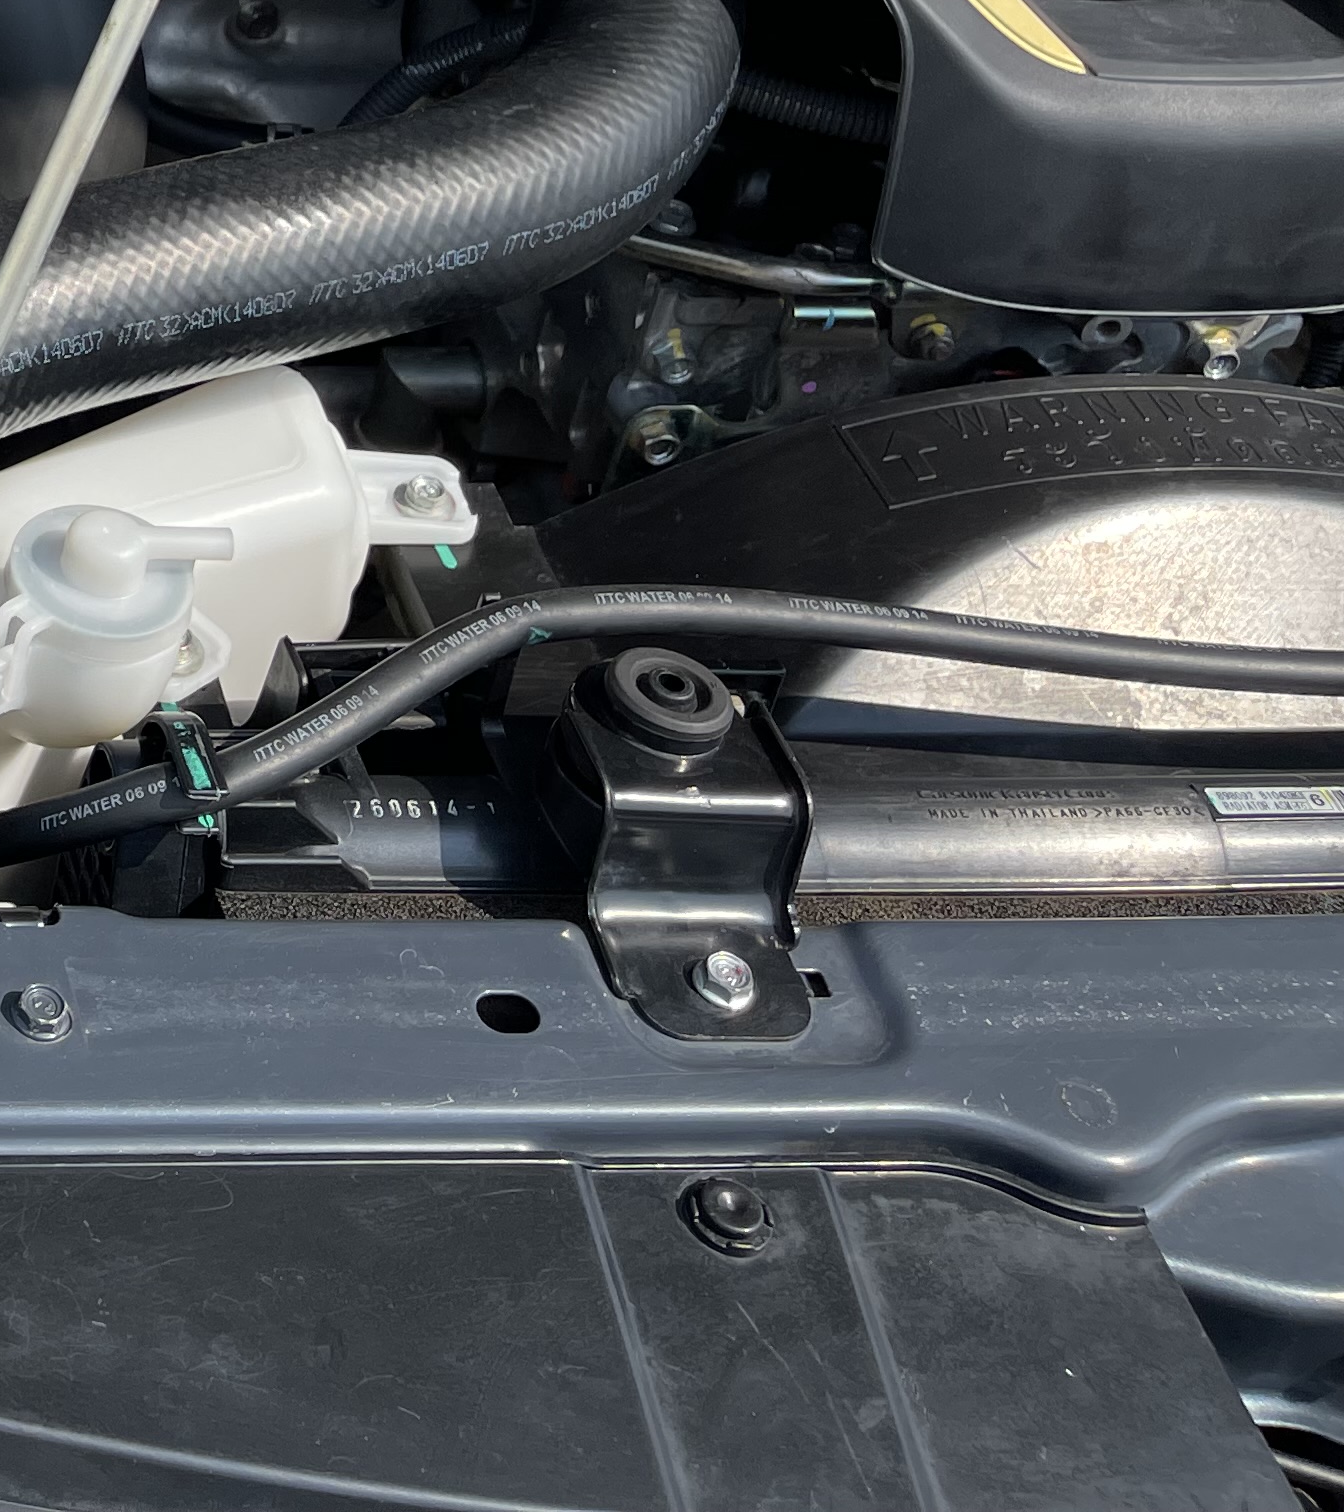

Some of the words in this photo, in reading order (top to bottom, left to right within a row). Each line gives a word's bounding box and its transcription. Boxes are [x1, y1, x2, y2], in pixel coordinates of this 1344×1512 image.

[626, 590, 679, 604] WATER
[715, 592, 733, 605] 14
[820, 599, 873, 616] WATER
[892, 607, 911, 619] 09
[911, 609, 928, 621] 14
[445, 618, 493, 649] WATER
[490, 610, 507, 627] 06
[505, 604, 523, 621] 09
[522, 599, 542, 615] 14
[282, 714, 333, 748] WATER
[331, 700, 349, 720] 06
[345, 694, 363, 712] 09
[69, 793, 124, 821] WATER
[125, 786, 145, 803] 06
[148, 779, 168, 794] 09
[172, 776, 181, 788] 1
[1222, 801, 1270, 811] RADIATOR
[1309, 793, 1325, 807] 6
[927, 807, 969, 819] MADE
[981, 807, 999, 818] IN
[1009, 807, 1088, 819] THAILAND
